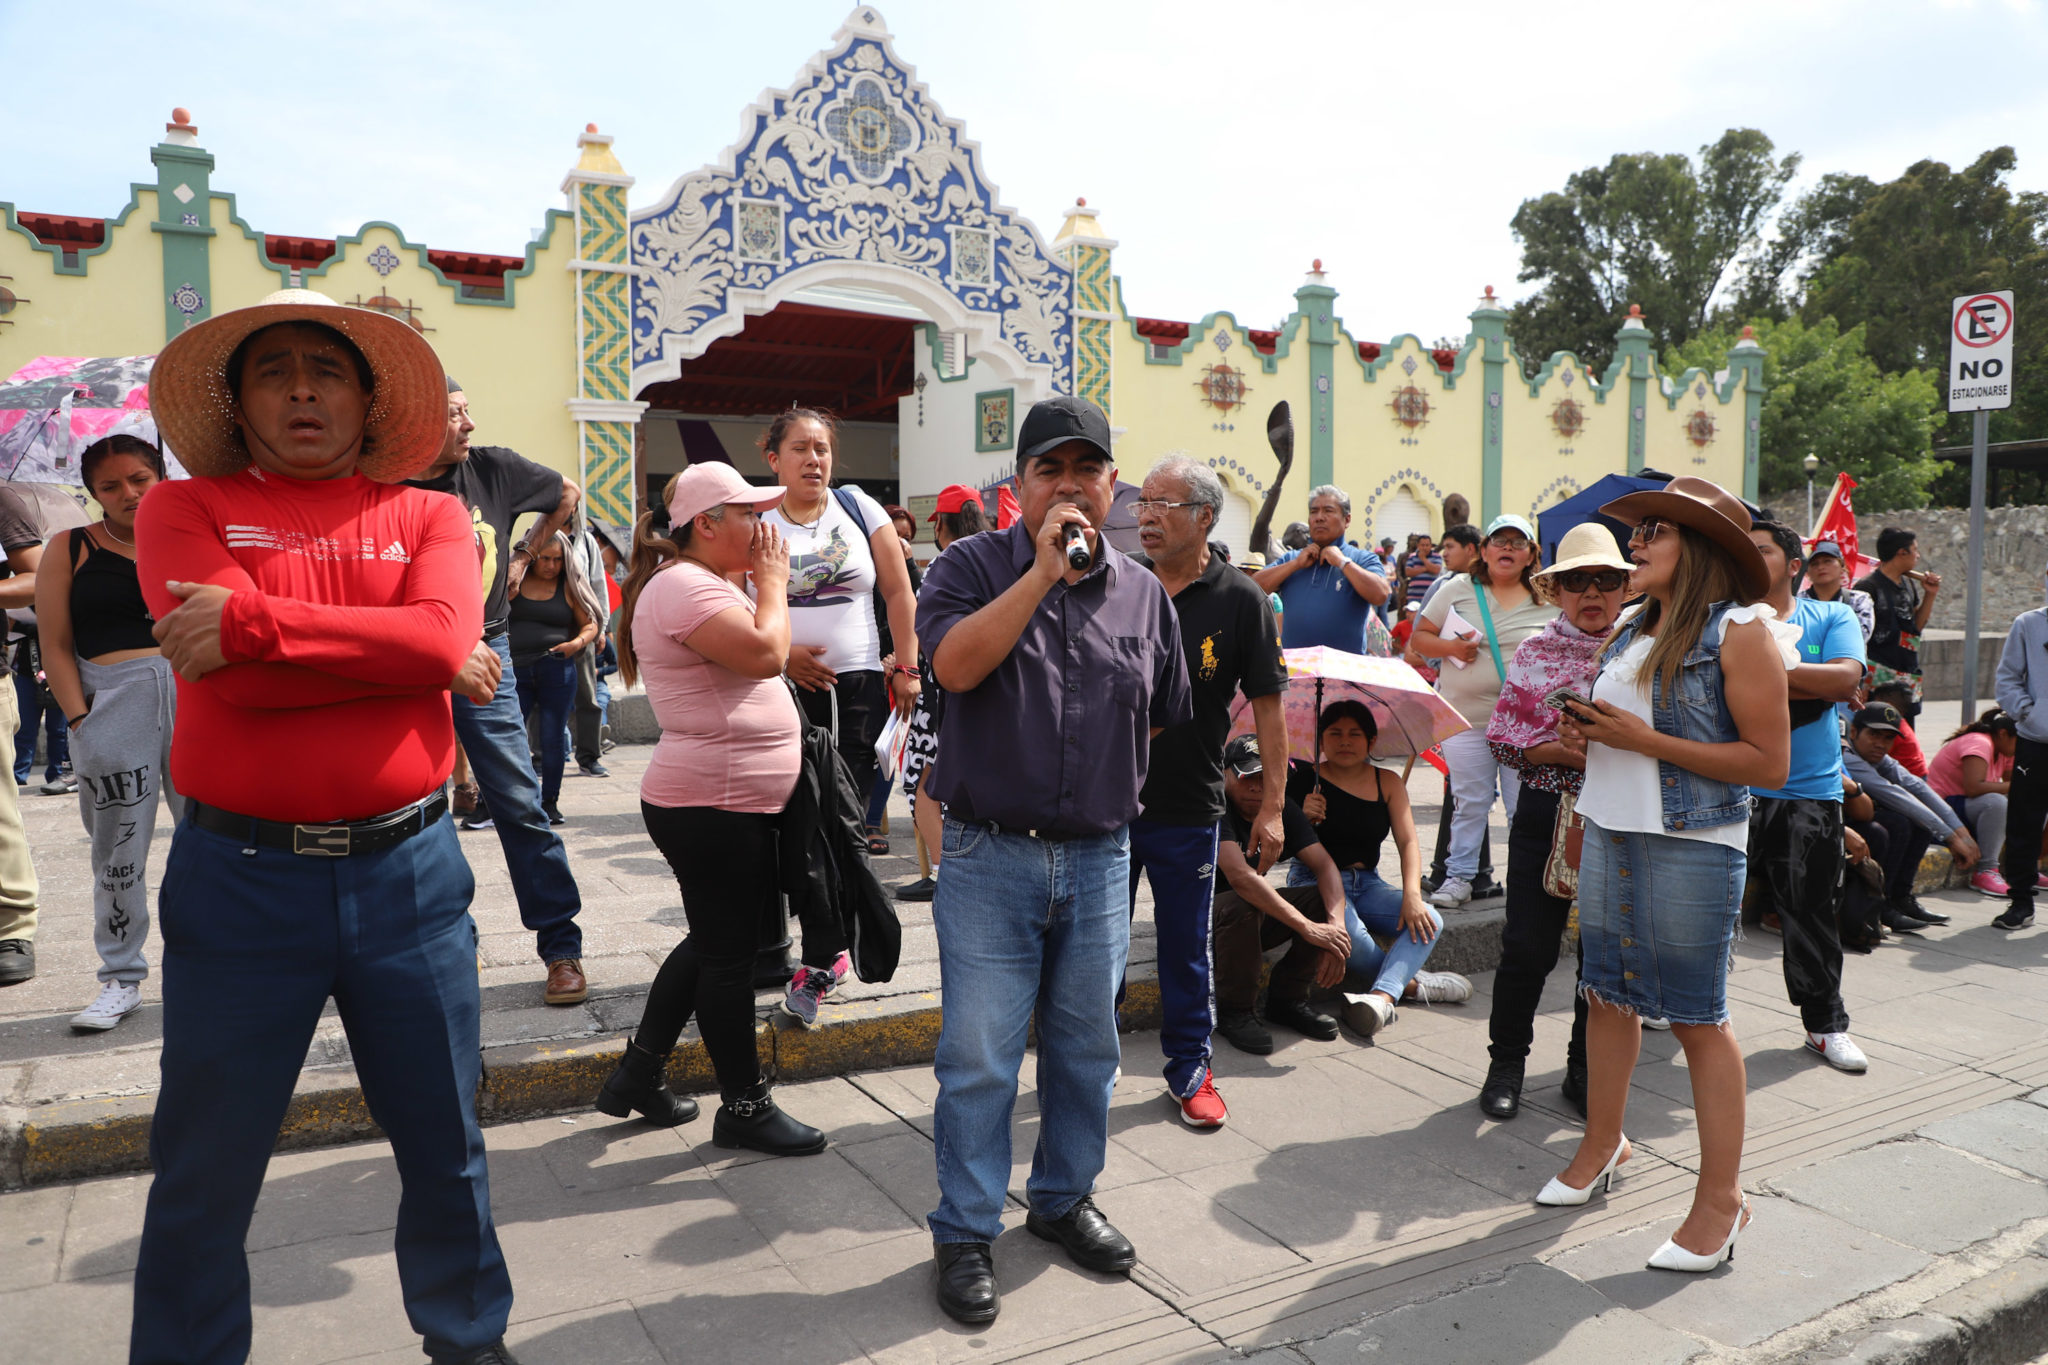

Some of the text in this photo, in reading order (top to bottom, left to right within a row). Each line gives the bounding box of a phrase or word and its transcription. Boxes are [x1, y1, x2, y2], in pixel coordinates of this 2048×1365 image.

[1969, 303, 1997, 340] E
[1959, 358, 2004, 381] NO
[1952, 384, 2009, 400] ESTACIONARSE
[379, 552, 412, 564] adidas
[79, 765, 149, 804] LIFE
[120, 880, 135, 892] for
